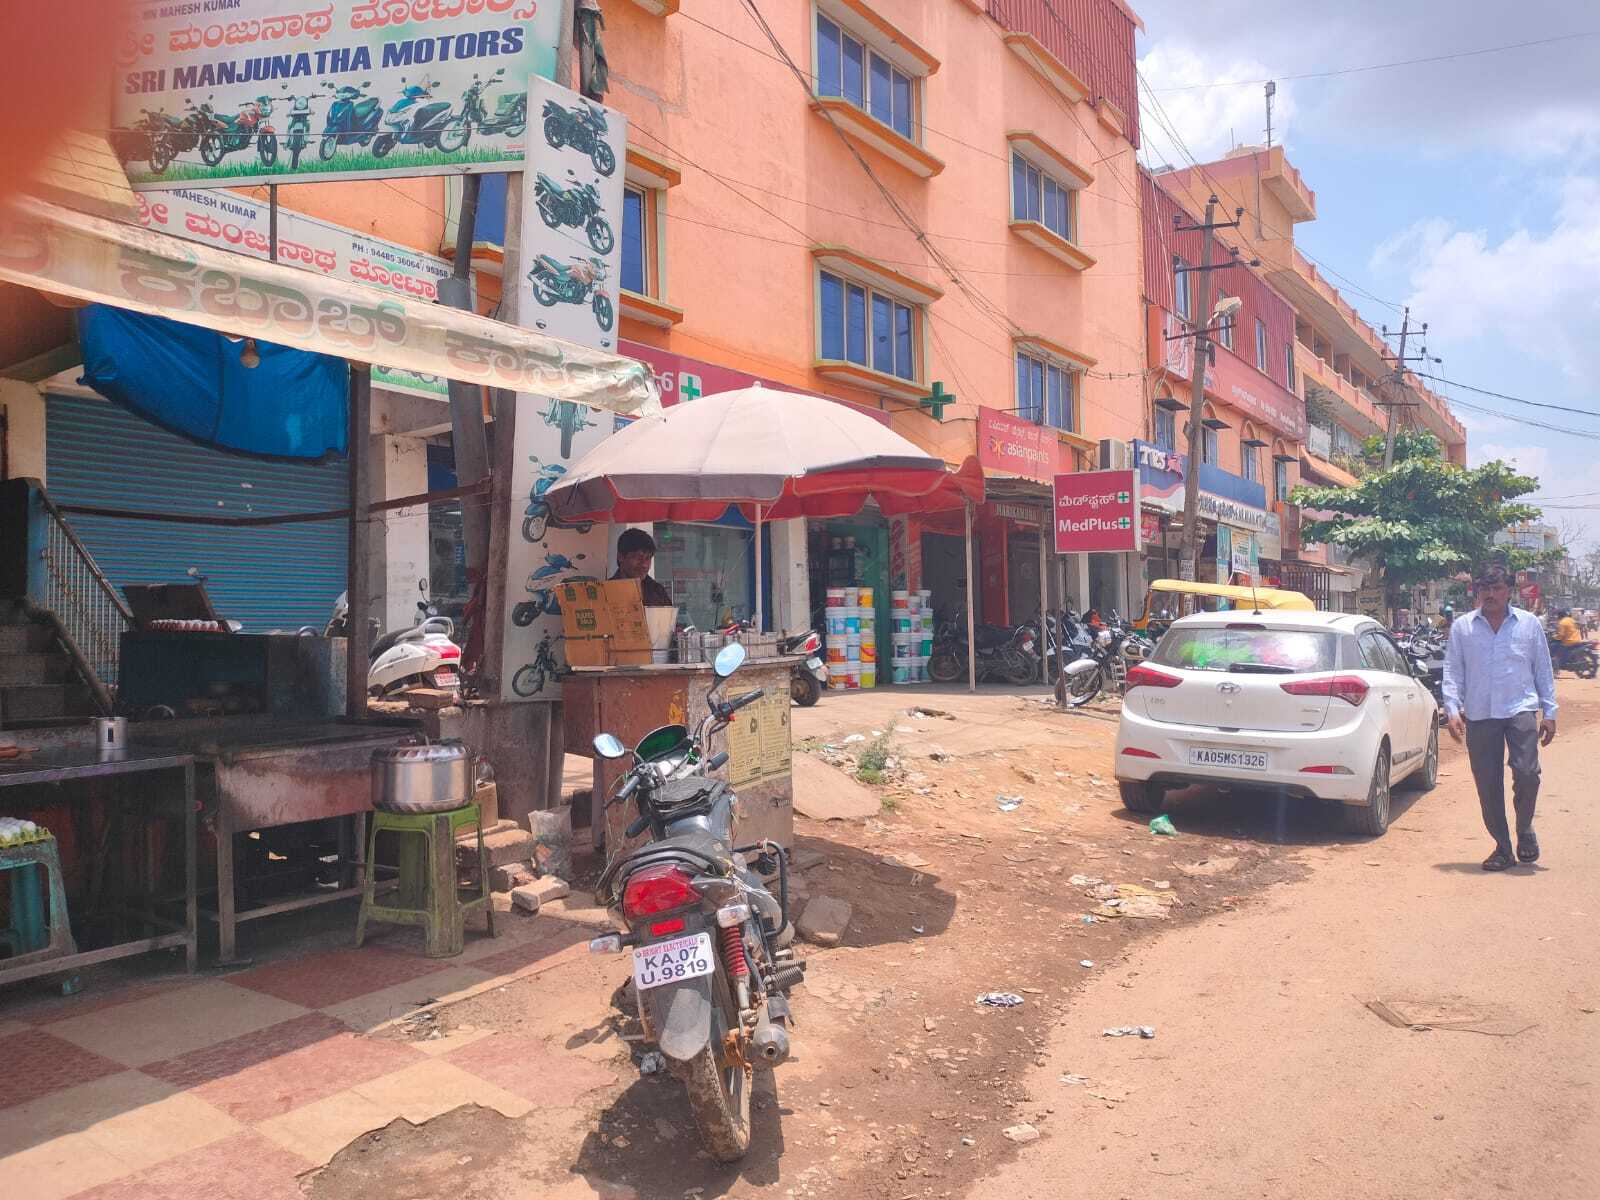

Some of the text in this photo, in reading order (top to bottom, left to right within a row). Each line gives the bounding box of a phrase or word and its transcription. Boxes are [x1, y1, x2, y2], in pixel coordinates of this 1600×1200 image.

[160, 2, 199, 18] MAHESH
[203, 0, 240, 12] KUMAR
[168, 4, 334, 52] ಮಂಜುನಾಥ
[125, 27, 524, 95] SRI MANJUNATHA MOTORS
[173, 189, 257, 220] MAHESH KUMAR
[1139, 444, 1167, 471] TVS
[1059, 518, 1118, 532] MedPlus
[644, 945, 699, 970] KA.07
[640, 958, 708, 985] U.9819
